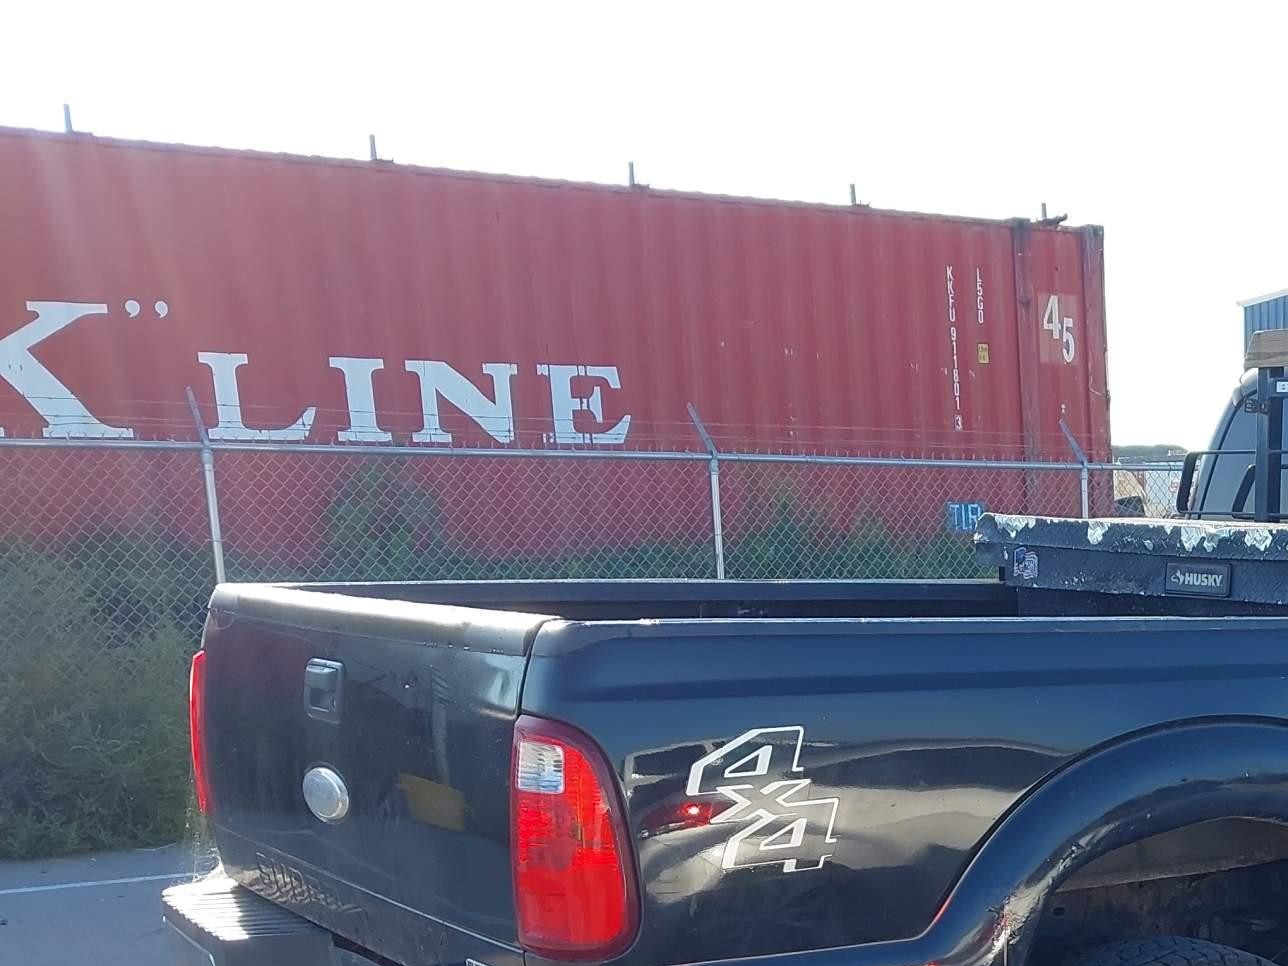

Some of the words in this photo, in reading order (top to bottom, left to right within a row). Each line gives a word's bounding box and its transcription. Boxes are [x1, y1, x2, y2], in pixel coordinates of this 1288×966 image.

[946, 265, 956, 322] KKFU
[1043, 295, 1075, 363] 45
[197, 351, 632, 444] LINE
[950, 326, 961, 411] 911801
[1184, 572, 1223, 587] HUSKY
